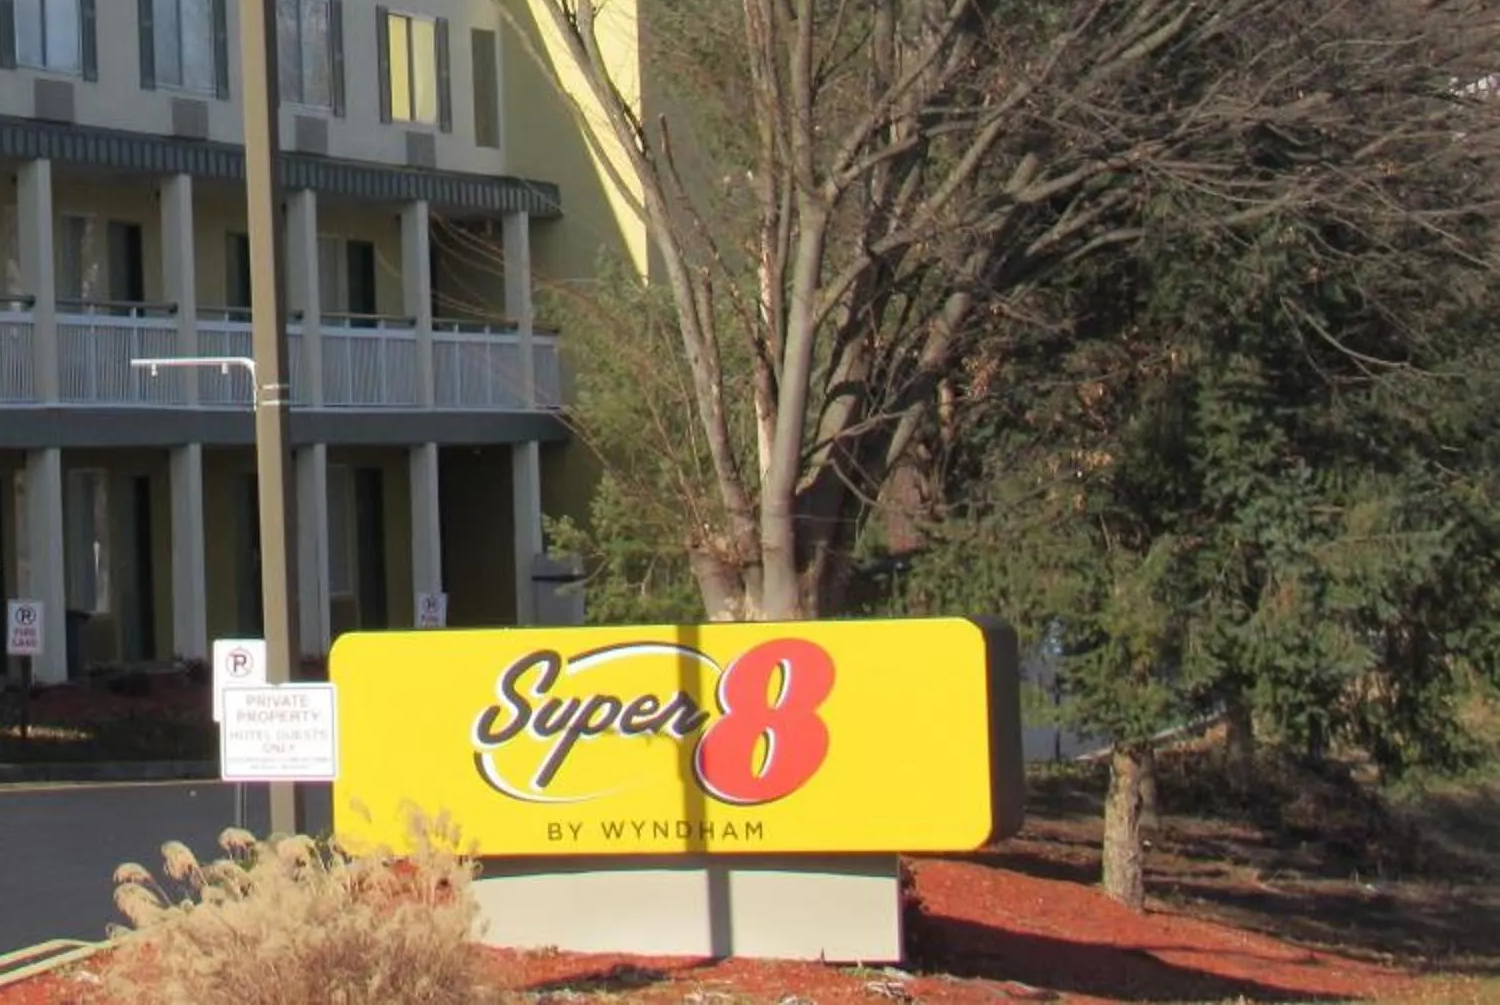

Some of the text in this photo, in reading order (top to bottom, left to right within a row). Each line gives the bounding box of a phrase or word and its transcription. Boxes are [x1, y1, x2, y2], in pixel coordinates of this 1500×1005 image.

[245, 694, 309, 708] PRIVATE
[236, 710, 320, 723] PROPERTY
[473, 637, 837, 806] Super 8
[547, 820, 764, 841] BY WYNDHAM
